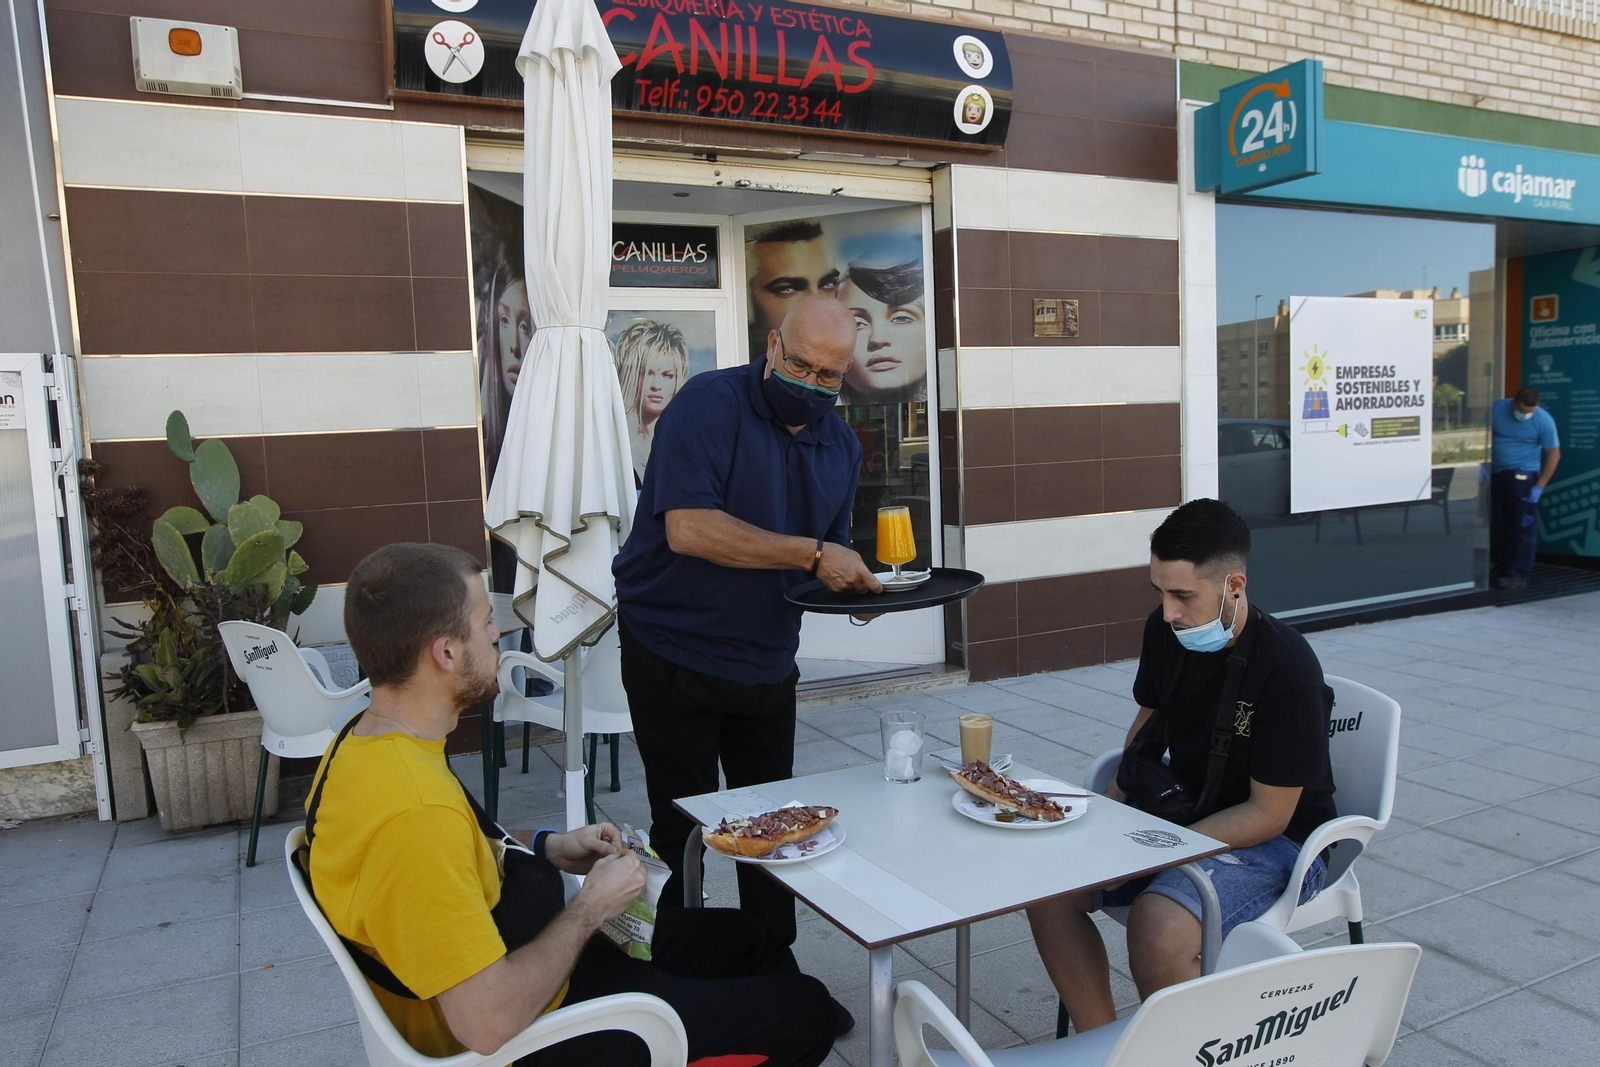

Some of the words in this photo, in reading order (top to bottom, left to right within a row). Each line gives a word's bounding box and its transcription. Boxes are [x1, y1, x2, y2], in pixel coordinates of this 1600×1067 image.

[748, 4, 763, 22] Y
[770, 7, 873, 38] ESTÉTICA
[601, 7, 876, 94] CANILLAS
[696, 85, 744, 115] 950
[752, 91, 778, 119] 22
[1492, 164, 1576, 203] cajamar
[612, 240, 708, 263] CANILLAS
[612, 264, 708, 275] PELUQUEROS
[1530, 325, 1570, 339] Oficina
[1573, 324, 1597, 334] con
[1335, 365, 1396, 380] EMPRESAS
[1335, 380, 1410, 396] SOSTENIBLES
[1413, 379, 1422, 393] Y
[1335, 394, 1425, 412] AHORRADORAS
[1260, 983, 1314, 1000] CERVEZAS
[1270, 1054, 1295, 1067] 1890
